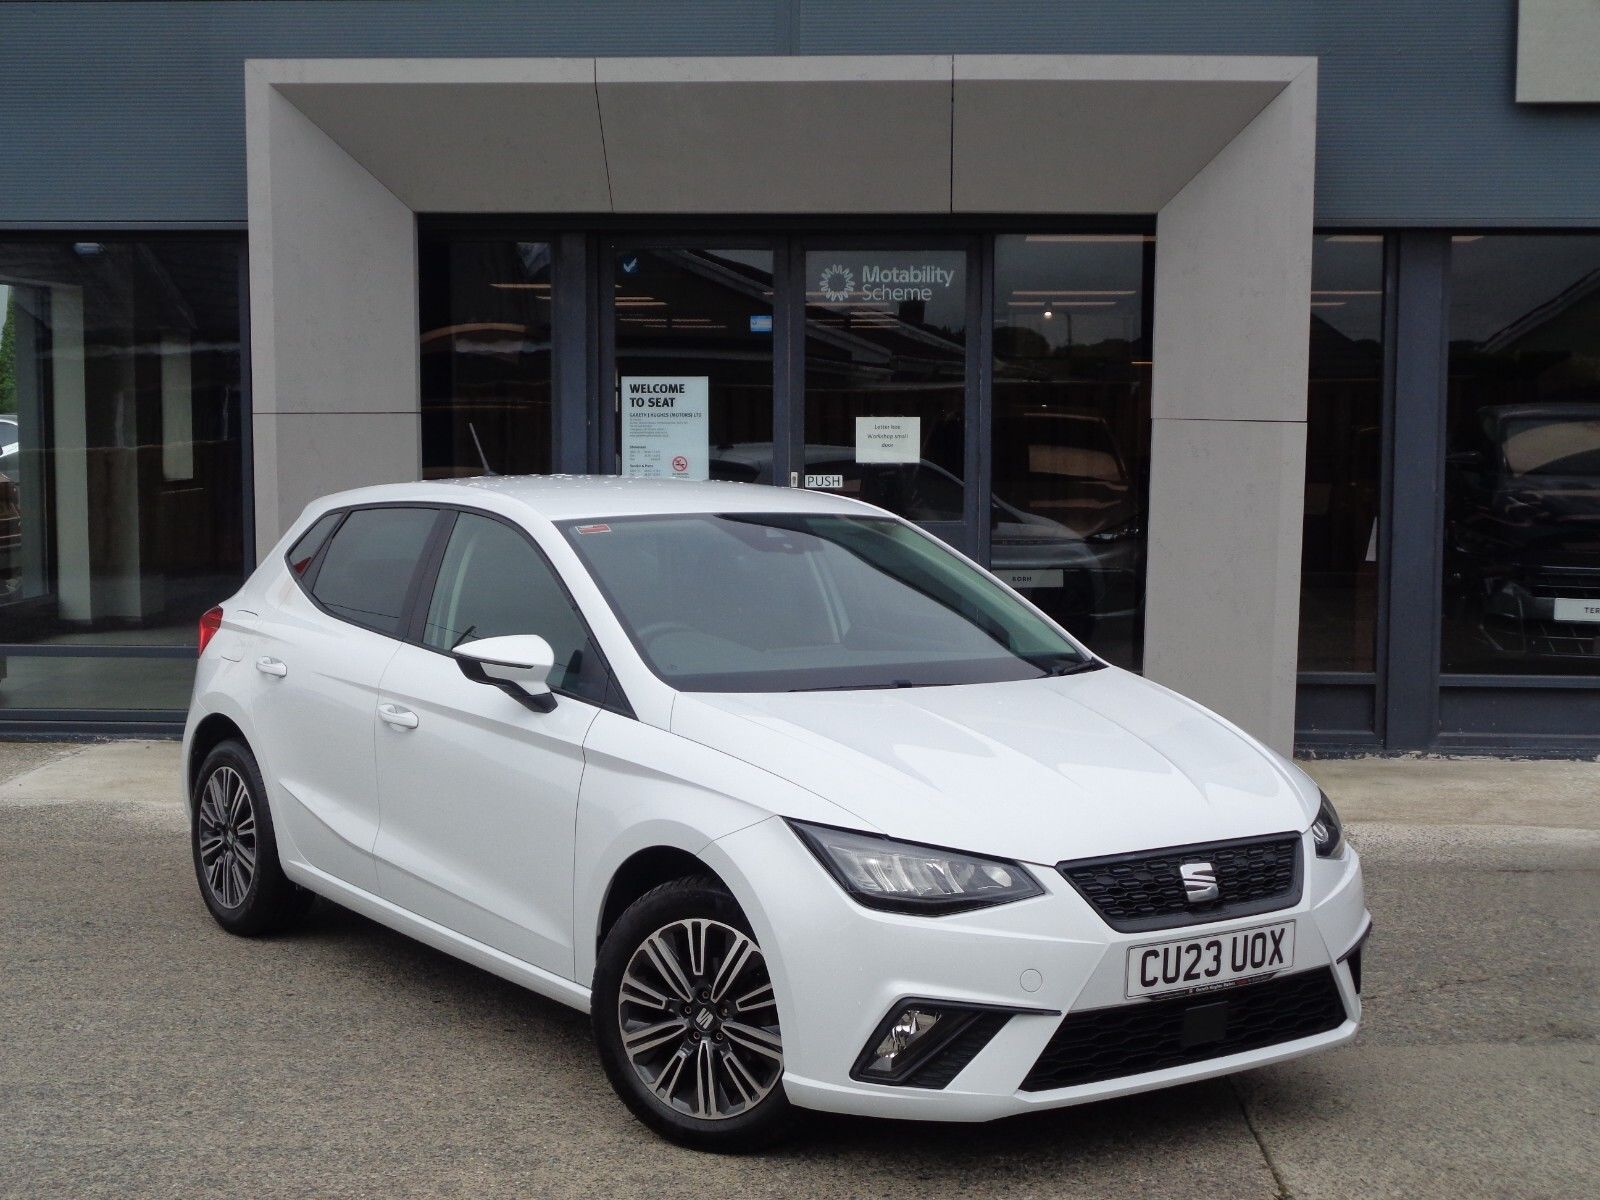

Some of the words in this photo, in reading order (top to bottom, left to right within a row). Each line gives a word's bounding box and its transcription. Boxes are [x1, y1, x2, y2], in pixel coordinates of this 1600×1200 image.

[862, 265, 955, 287] Motability
[862, 284, 933, 301] Scheme
[629, 383, 686, 394] WELCOME
[629, 397, 645, 408] TO
[647, 397, 676, 408] SEAT
[807, 475, 840, 487] PUSH
[1140, 940, 1222, 988] CU23
[1231, 928, 1285, 973] UOX
